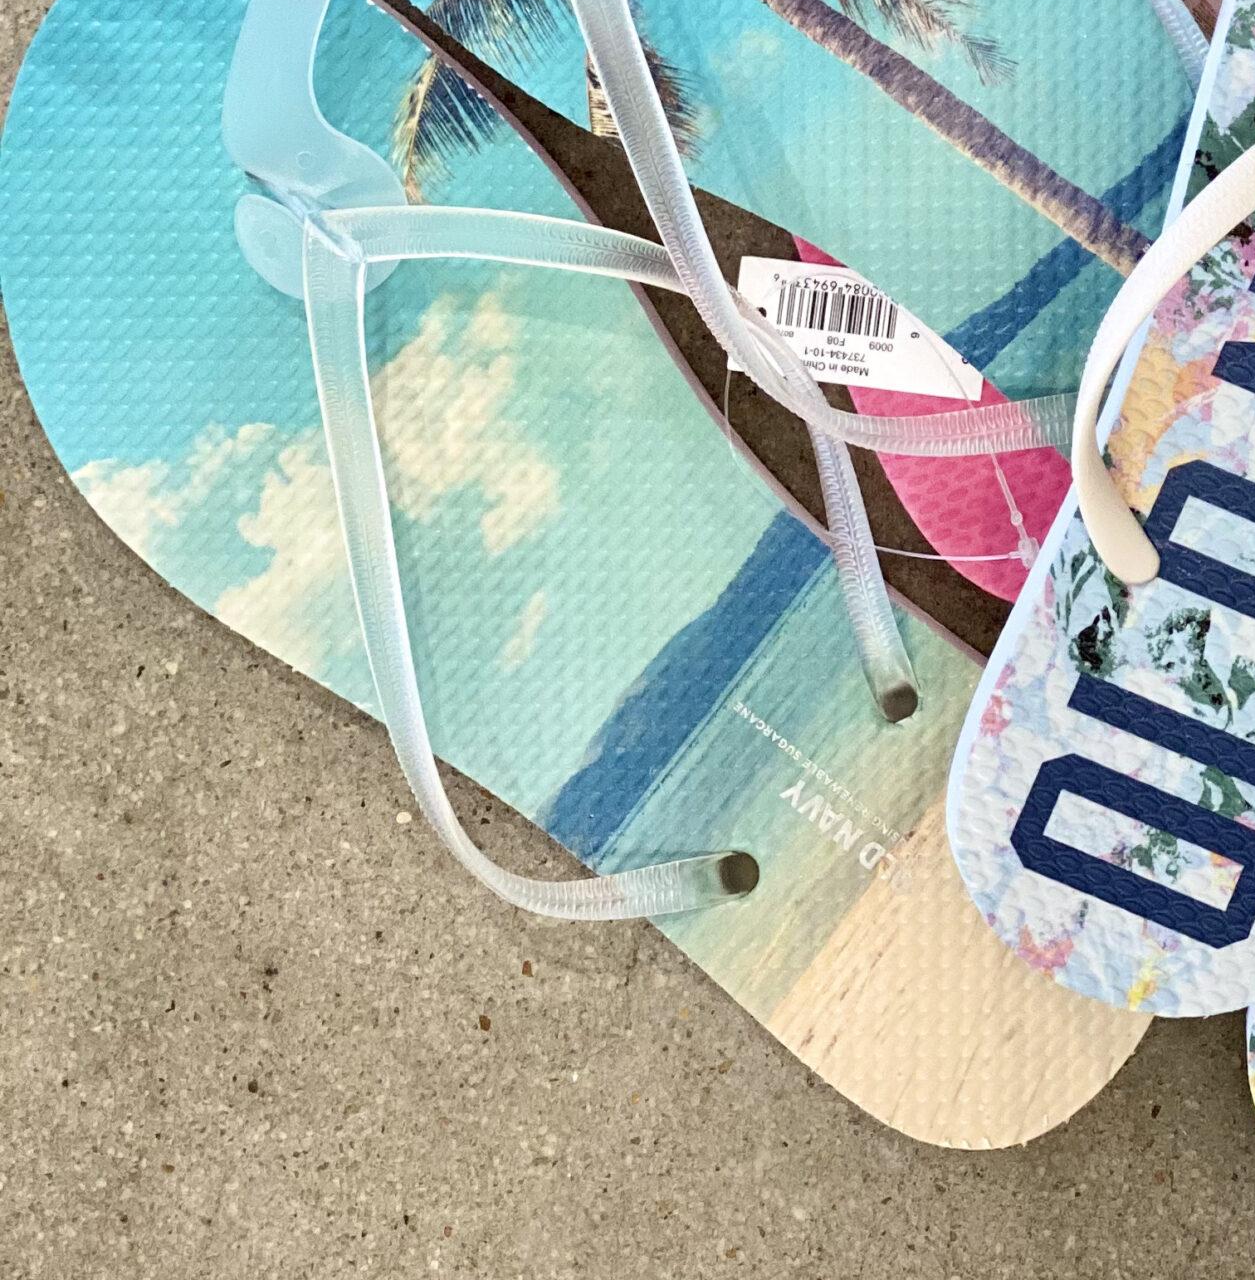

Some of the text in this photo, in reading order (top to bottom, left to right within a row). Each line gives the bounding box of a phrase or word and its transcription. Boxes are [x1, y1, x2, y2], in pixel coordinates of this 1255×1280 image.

[827, 336, 845, 346] F08
[869, 341, 893, 352] 0009
[804, 346, 866, 363] 737434-10-1
[800, 360, 869, 376] Made in Chin
[733, 701, 802, 761] SUGARCANE
[779, 779, 864, 851] NAVY
